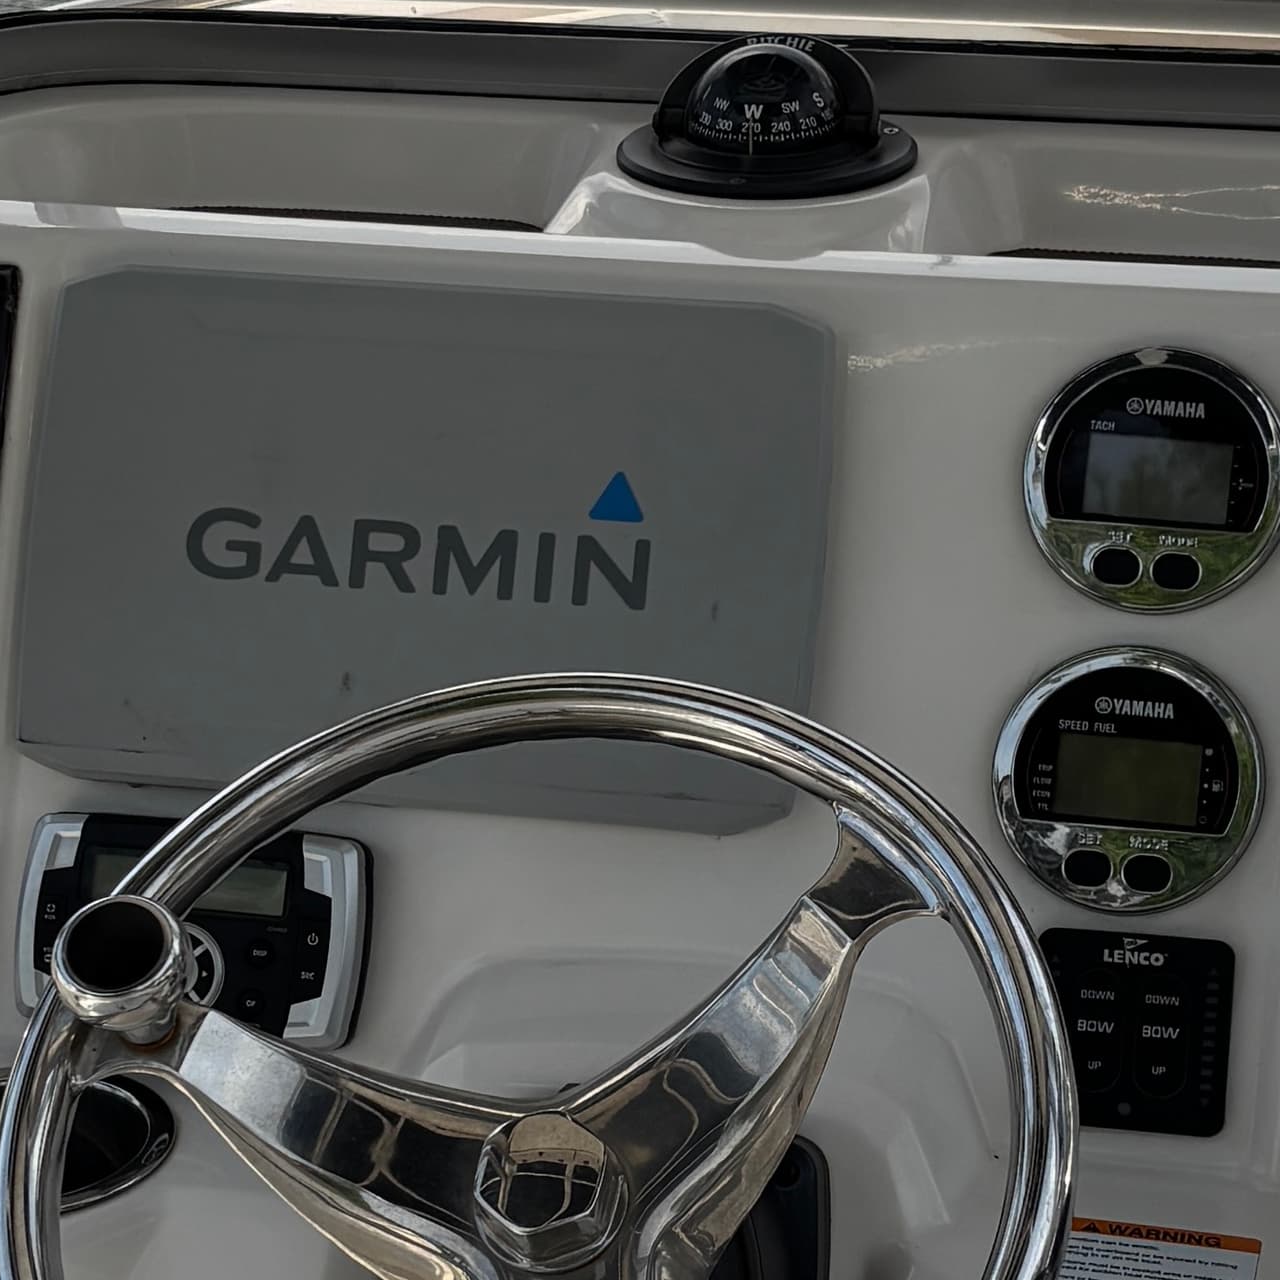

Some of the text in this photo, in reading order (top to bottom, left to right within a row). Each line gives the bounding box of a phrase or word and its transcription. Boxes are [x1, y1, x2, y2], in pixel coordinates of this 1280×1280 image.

[812, 92, 824, 107] S
[744, 104, 763, 119] W
[781, 100, 799, 113] SW
[771, 121, 790, 133] 240
[800, 116, 817, 129] 210
[1145, 399, 1205, 419] YAMAHA
[1090, 420, 1116, 431] TACH
[185, 507, 651, 610] GARMIN
[1114, 698, 1174, 719] YAMAHA
[1058, 719, 1118, 733] SPEED FUEL
[1103, 948, 1164, 967] LENCO
[1080, 989, 1180, 1006] DOWN DOWN
[1077, 1019, 1180, 1039] BOW BOW
[1087, 1060, 1166, 1075] UP UP
[1107, 1223, 1222, 1247] WARNING
